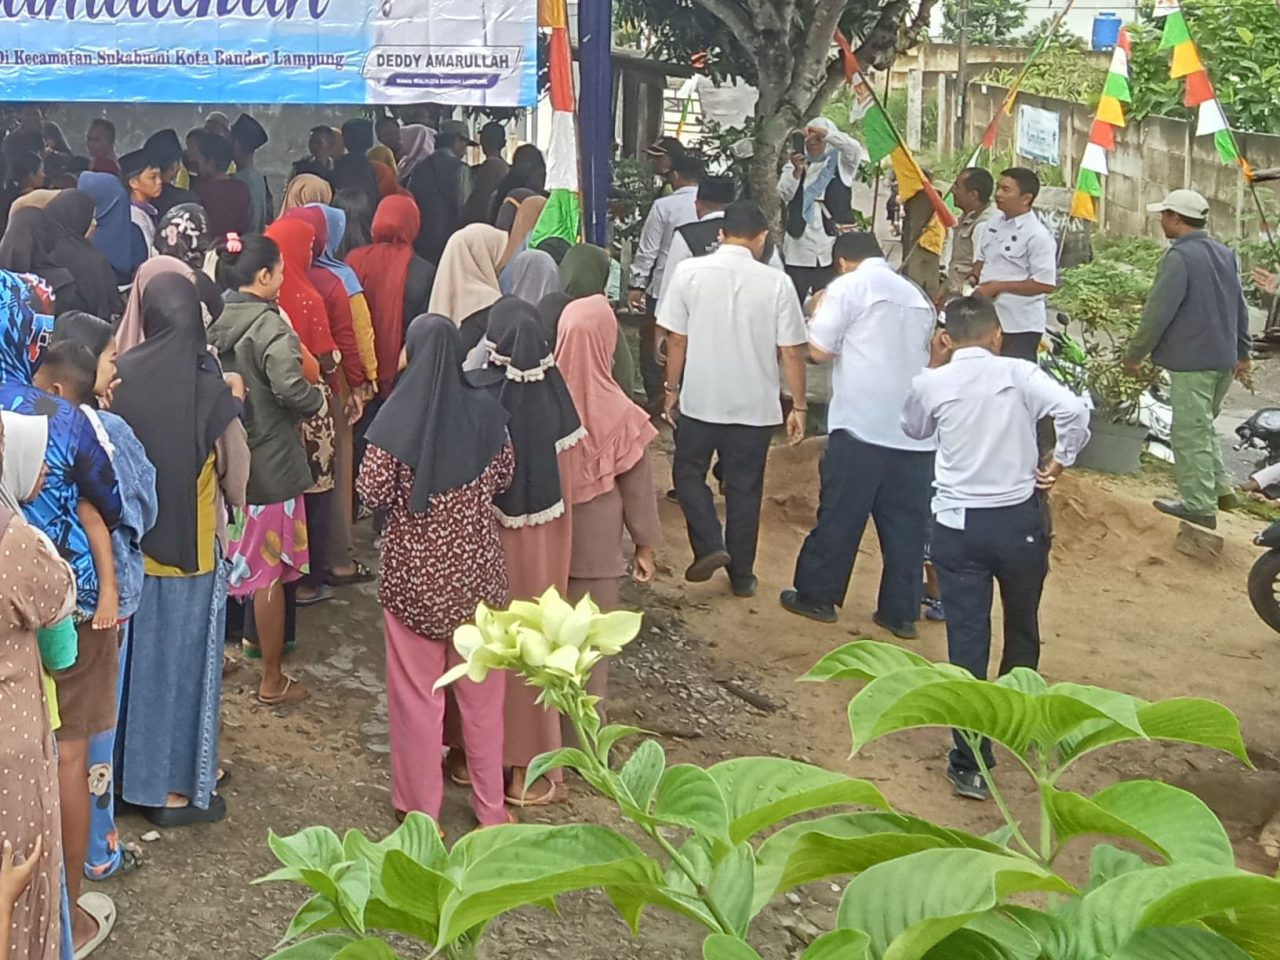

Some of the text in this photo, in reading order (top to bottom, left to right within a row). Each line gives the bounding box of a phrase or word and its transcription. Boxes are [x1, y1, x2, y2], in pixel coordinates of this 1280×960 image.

[14, 50, 92, 66] Kecamatan
[97, 49, 170, 65] Sukabumi
[175, 50, 210, 65] Kota
[214, 50, 269, 66] Bandar
[273, 50, 345, 70] Lampung
[376, 54, 509, 69] DEDDY AMARULLAH
